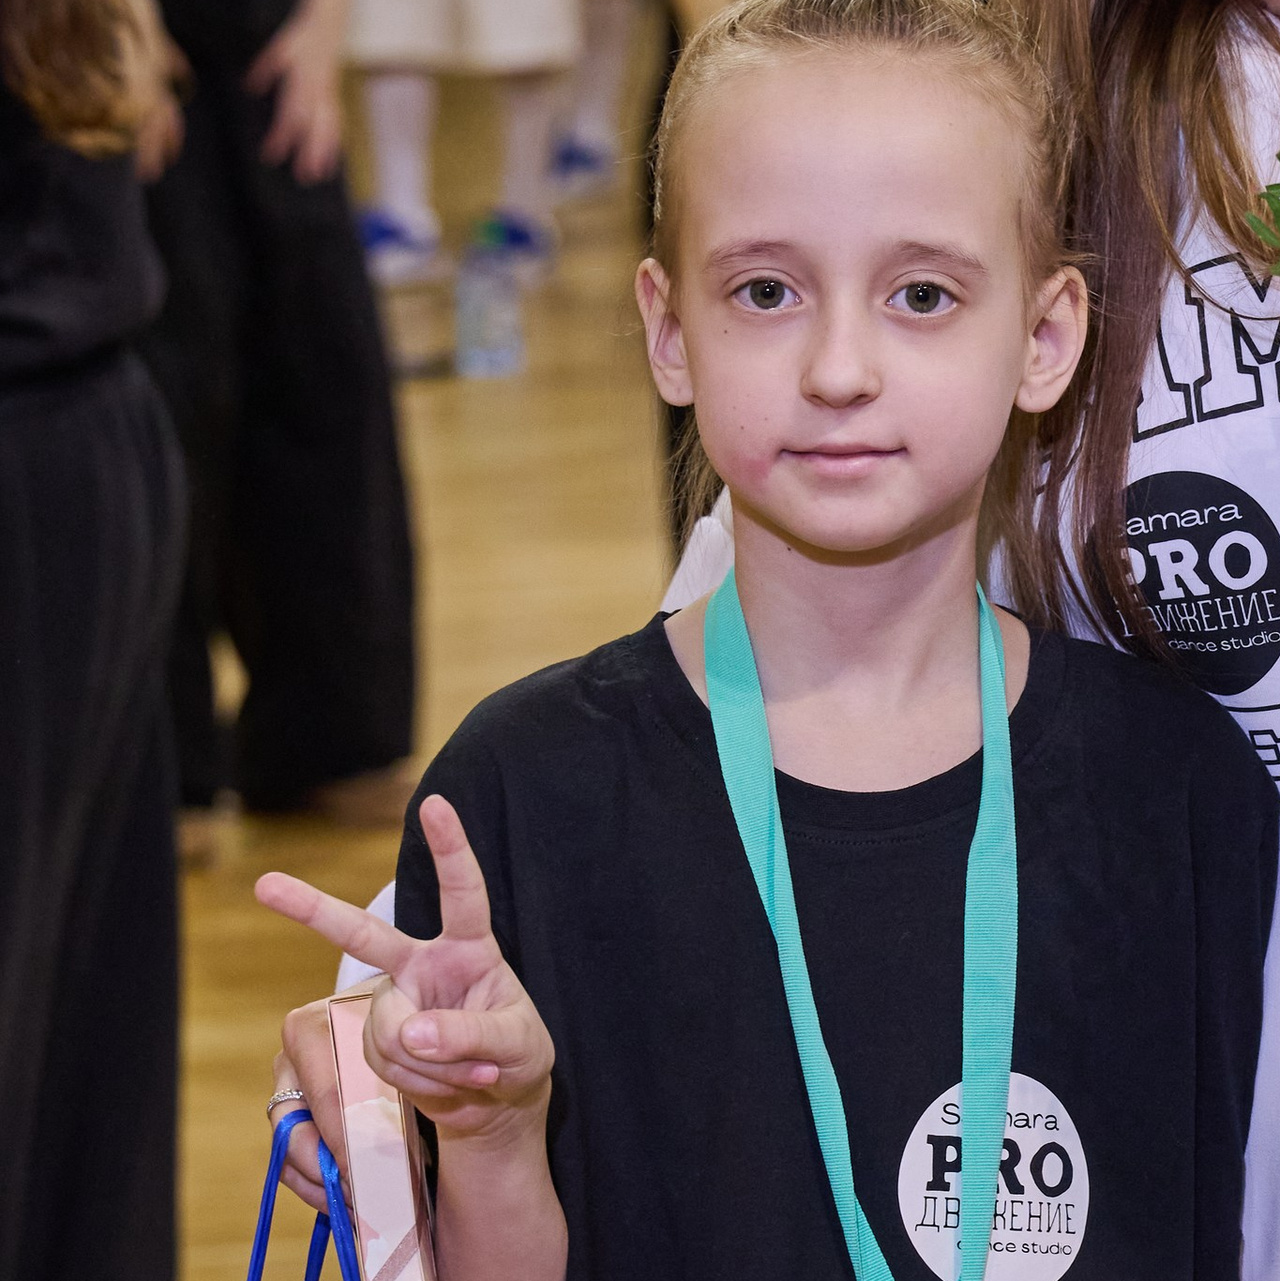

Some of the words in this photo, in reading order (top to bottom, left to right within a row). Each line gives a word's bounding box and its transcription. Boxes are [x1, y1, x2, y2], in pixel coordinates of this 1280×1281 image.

[1124, 503, 1243, 535] amara
[941, 1103, 1060, 1131] Sara
[915, 1196, 1077, 1235] ДВЖЕНИЕ
[1021, 1241, 1073, 1256] studio
